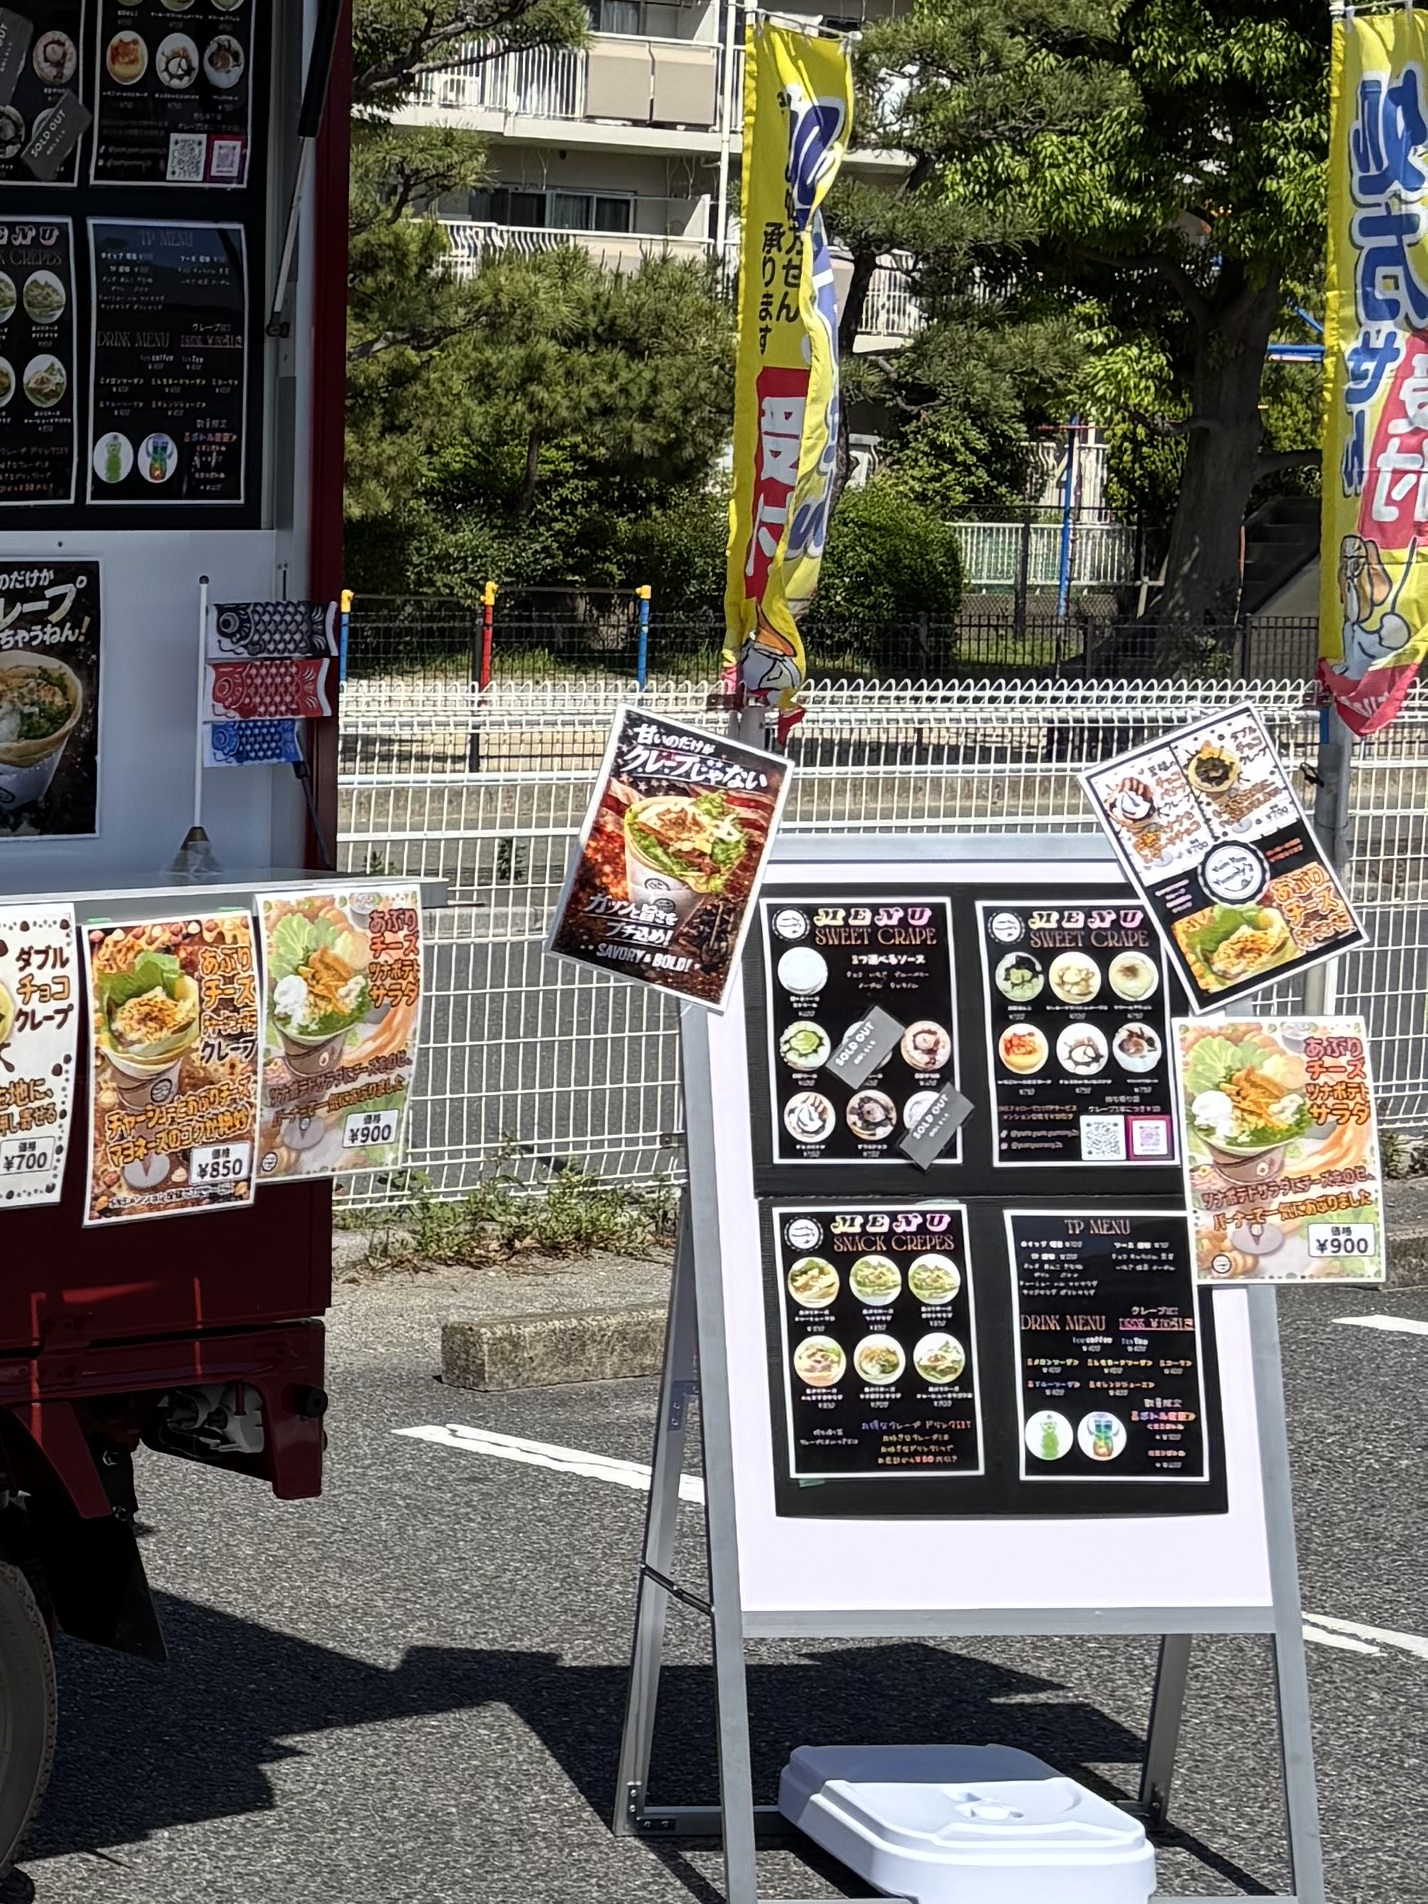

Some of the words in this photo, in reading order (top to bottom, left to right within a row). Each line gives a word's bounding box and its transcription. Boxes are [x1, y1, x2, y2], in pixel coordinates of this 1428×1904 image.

[30, 126, 52, 159] SOLD
[49, 107, 67, 132] OUT
[758, 221, 787, 356] 承ります
[633, 723, 717, 757] 甘いのだけが
[620, 745, 768, 790] クレープじゃない
[368, 908, 418, 933] あぶり
[813, 907, 933, 927] MENU
[1028, 909, 1144, 930] MENU
[369, 930, 420, 959] チーズ
[814, 927, 872, 946] SWEET
[877, 927, 937, 946] CRAPE
[1030, 930, 1085, 948] SWEET
[1090, 930, 1149, 947] CRAPE
[16, 946, 70, 972] ダブル
[199, 947, 253, 976] あぶり
[596, 943, 645, 964] SAVORY
[652, 955, 694, 973] BOLD!
[16, 974, 71, 1005] チョコ
[202, 975, 256, 1011] チーズ
[369, 982, 420, 1008] サラダ
[14, 1002, 75, 1033] クレープ
[199, 1038, 256, 1065] クレープ
[835, 1040, 860, 1066] SOLD
[855, 1021, 876, 1044] OUT
[1304, 1036, 1364, 1058] あぶり
[1305, 1057, 1367, 1080] チーズ
[911, 1114, 933, 1140] SOLD
[930, 1093, 950, 1115] OUT
[1309, 1102, 1371, 1126] サラダ
[348, 1123, 392, 1144] ¥900
[2, 1152, 48, 1172] ¥700
[197, 1159, 243, 1178] ¥850
[830, 1213, 951, 1234] MENU
[1064, 1219, 1084, 1235] TP
[1089, 1219, 1131, 1235] MENU
[833, 1235, 887, 1252] SNACK
[891, 1234, 955, 1252] CREPES
[1315, 1236, 1369, 1255] ¥900
[1020, 1314, 1061, 1331] DRINK
[1065, 1314, 1106, 1331] MENU
